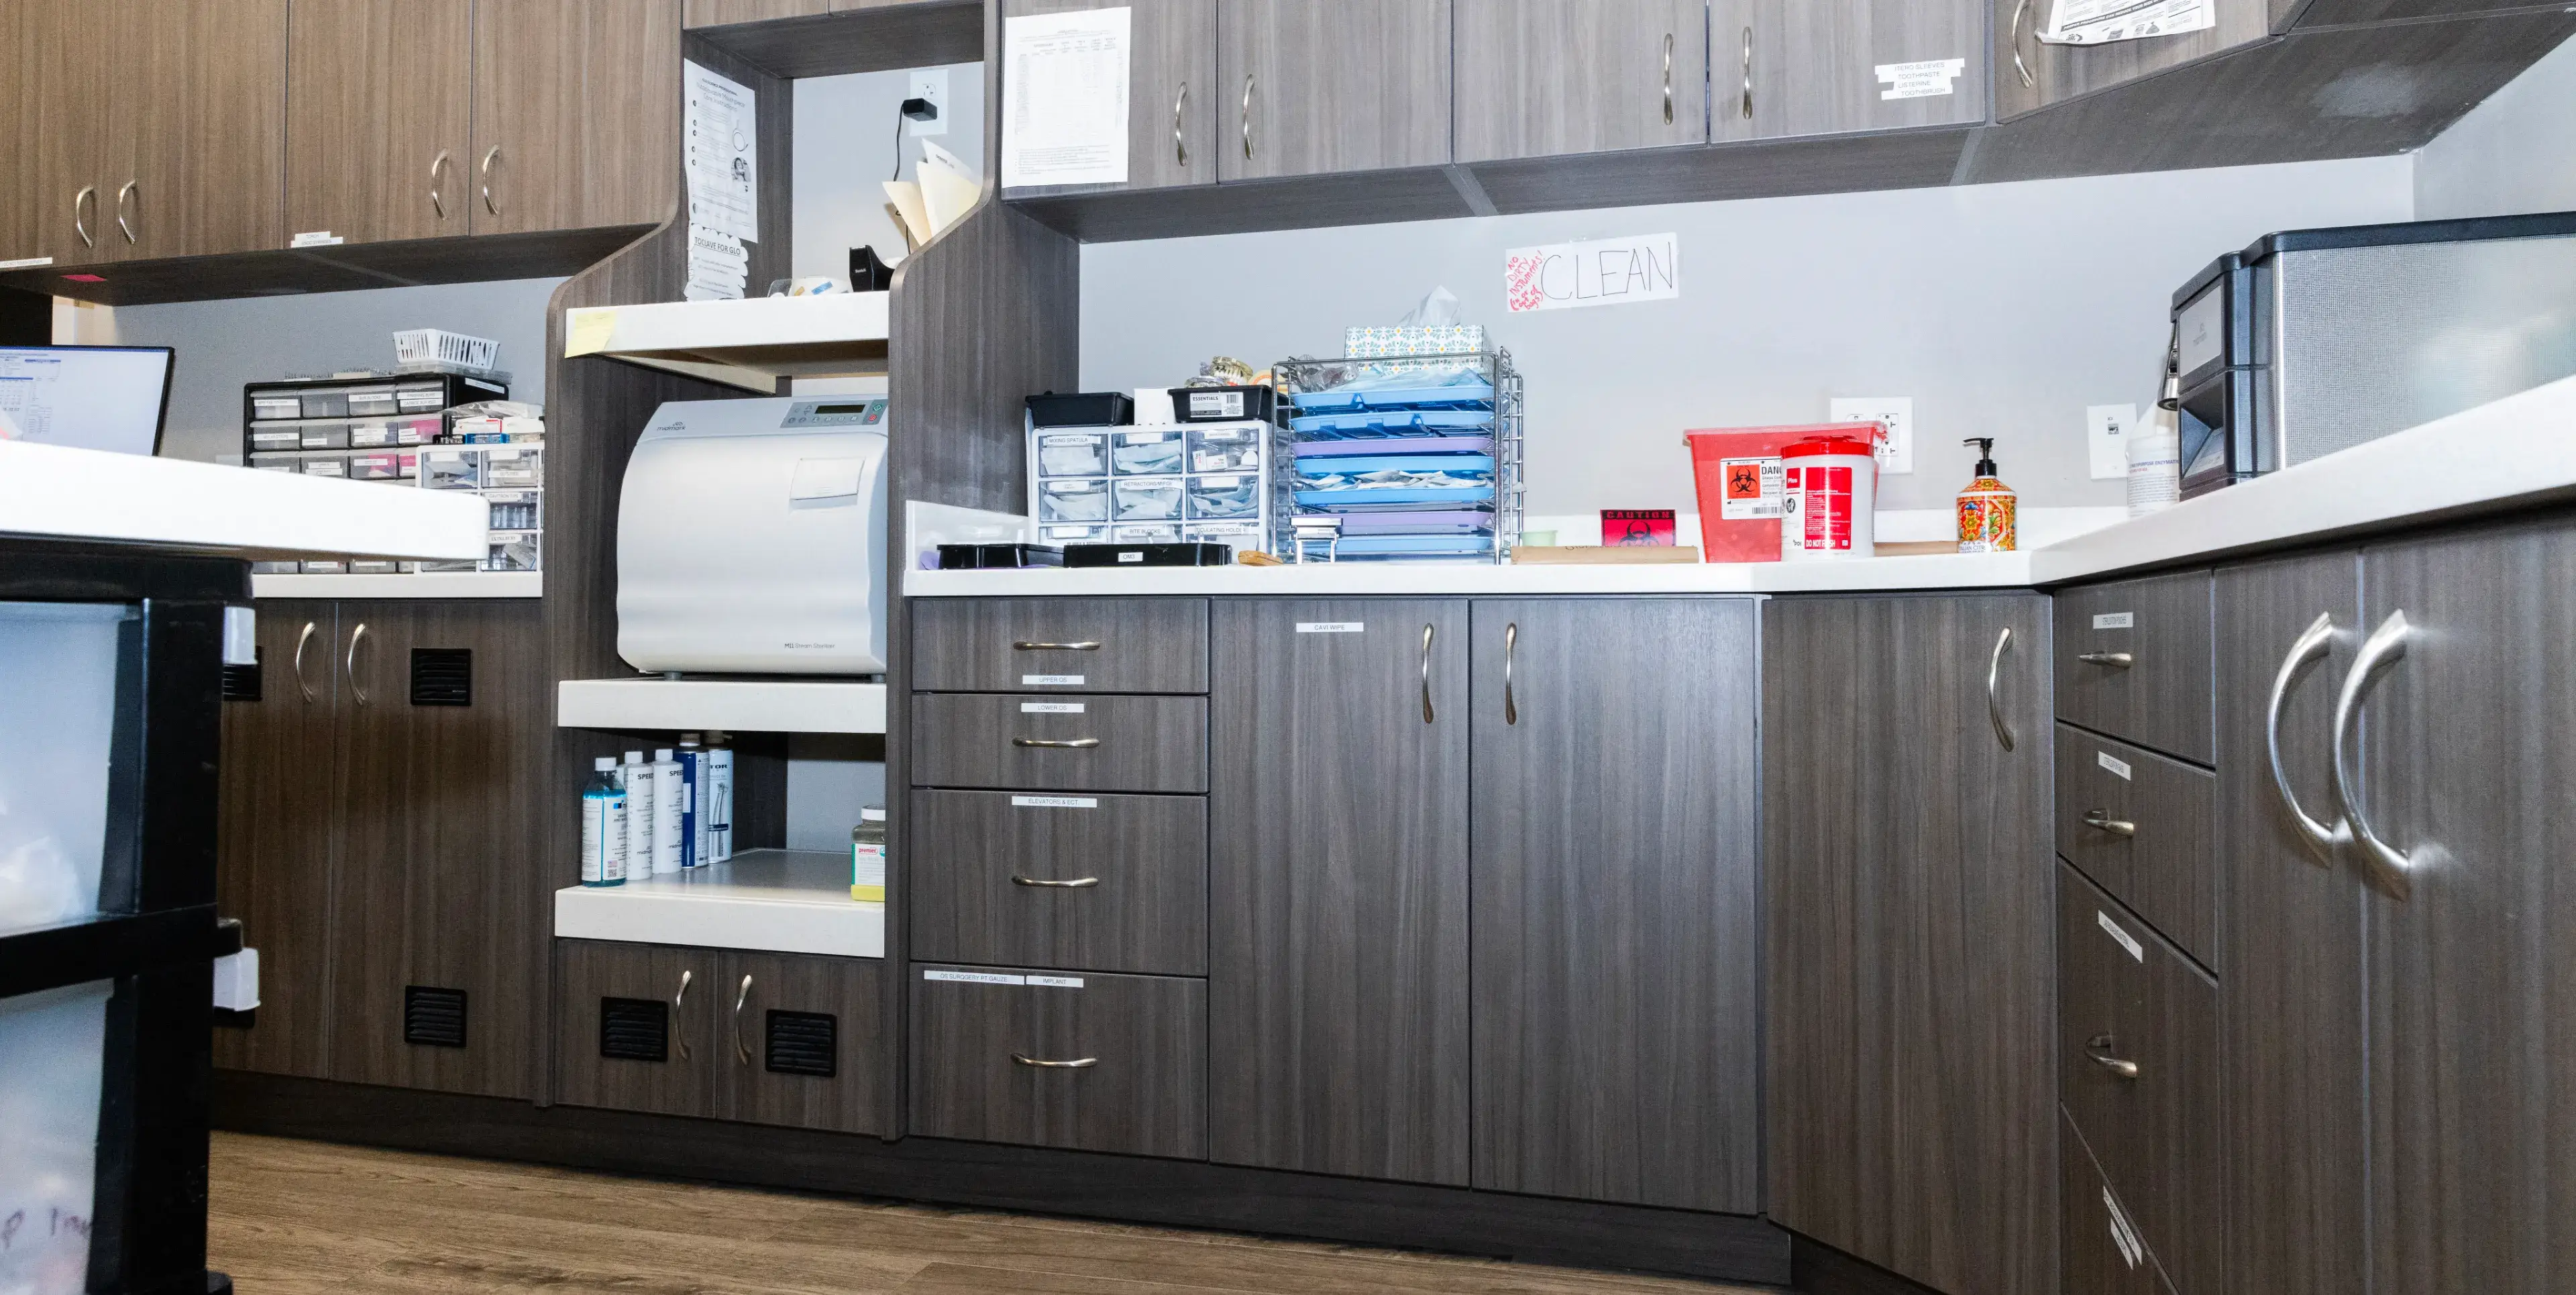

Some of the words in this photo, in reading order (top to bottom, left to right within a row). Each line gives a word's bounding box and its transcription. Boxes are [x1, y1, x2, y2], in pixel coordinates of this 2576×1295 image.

[1915, 62, 1945, 70] SLEEVES
[1898, 71, 1940, 80] TOOTHPASTE
[1898, 81, 1931, 89] LISTERINE
[1901, 87, 1945, 97] TOOTHBRUSH
[717, 244, 729, 253] FOR
[729, 246, 741, 256] GLO
[1507, 256, 1519, 270] NO
[1507, 257, 1532, 282] DIRTY
[1541, 242, 1672, 300] CLEAN
[1806, 539, 1812, 548] DO
[1813, 539, 1822, 548] NOT
